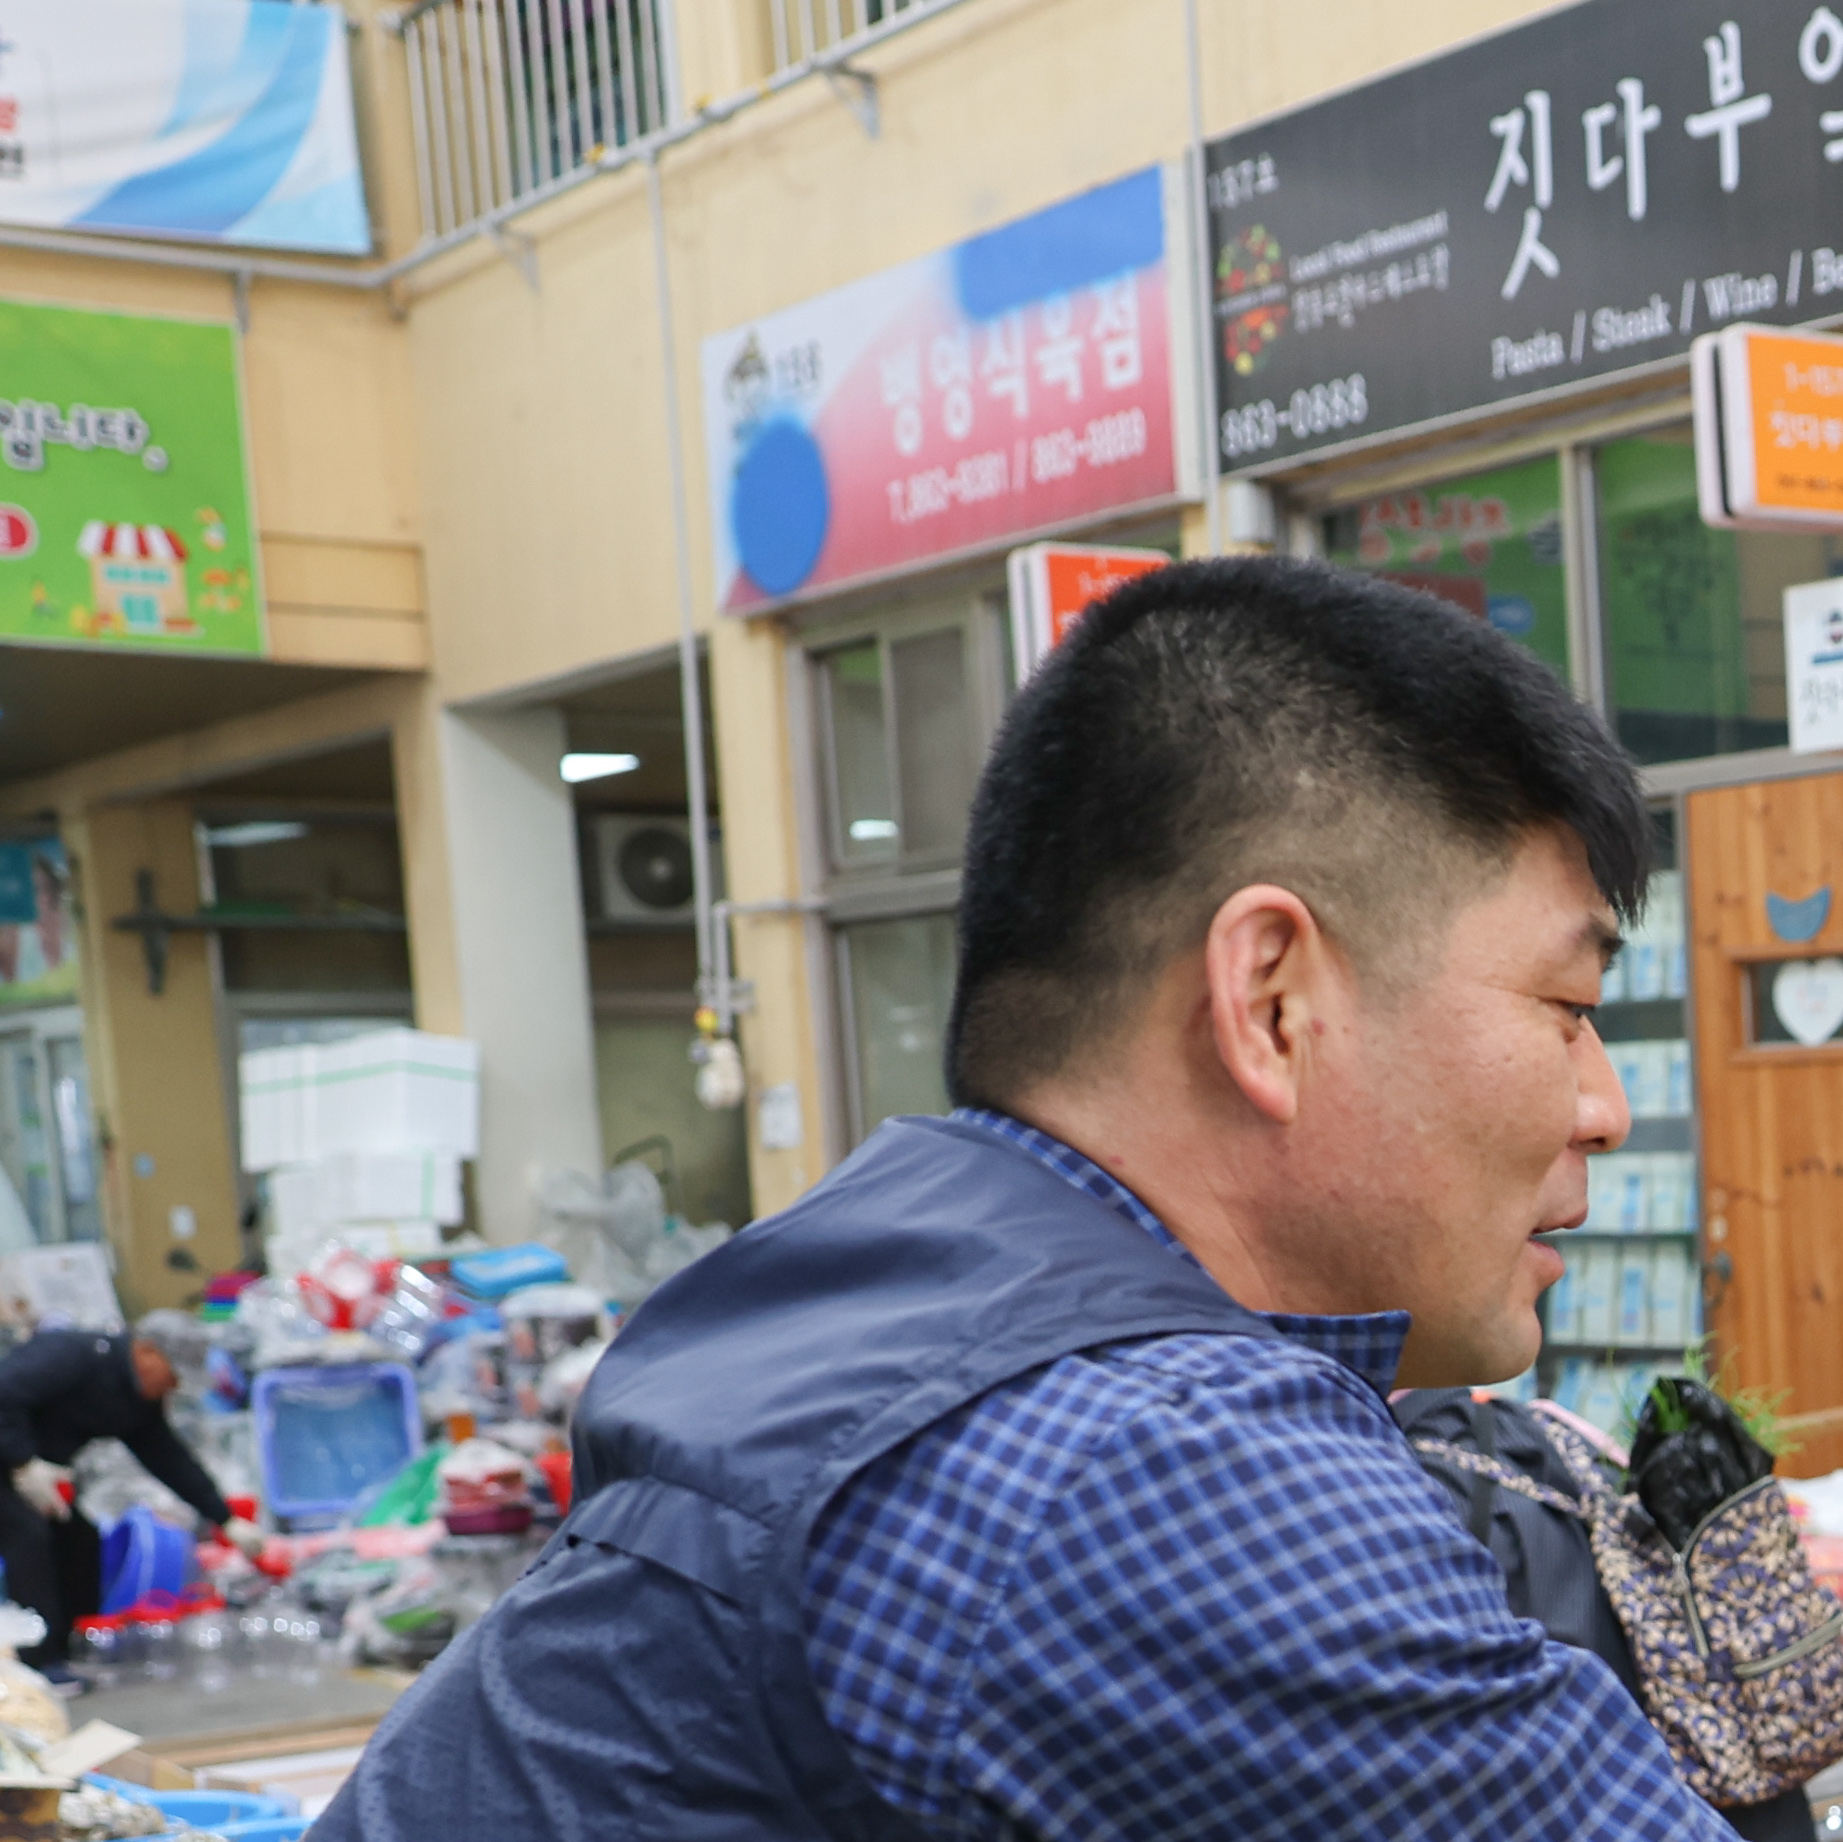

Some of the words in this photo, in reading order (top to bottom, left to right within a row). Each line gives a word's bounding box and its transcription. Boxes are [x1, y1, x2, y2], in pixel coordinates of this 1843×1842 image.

[1490, 327, 1565, 380] Pasta
[1591, 293, 1672, 352] Steak
[1703, 271, 1779, 321] Wine
